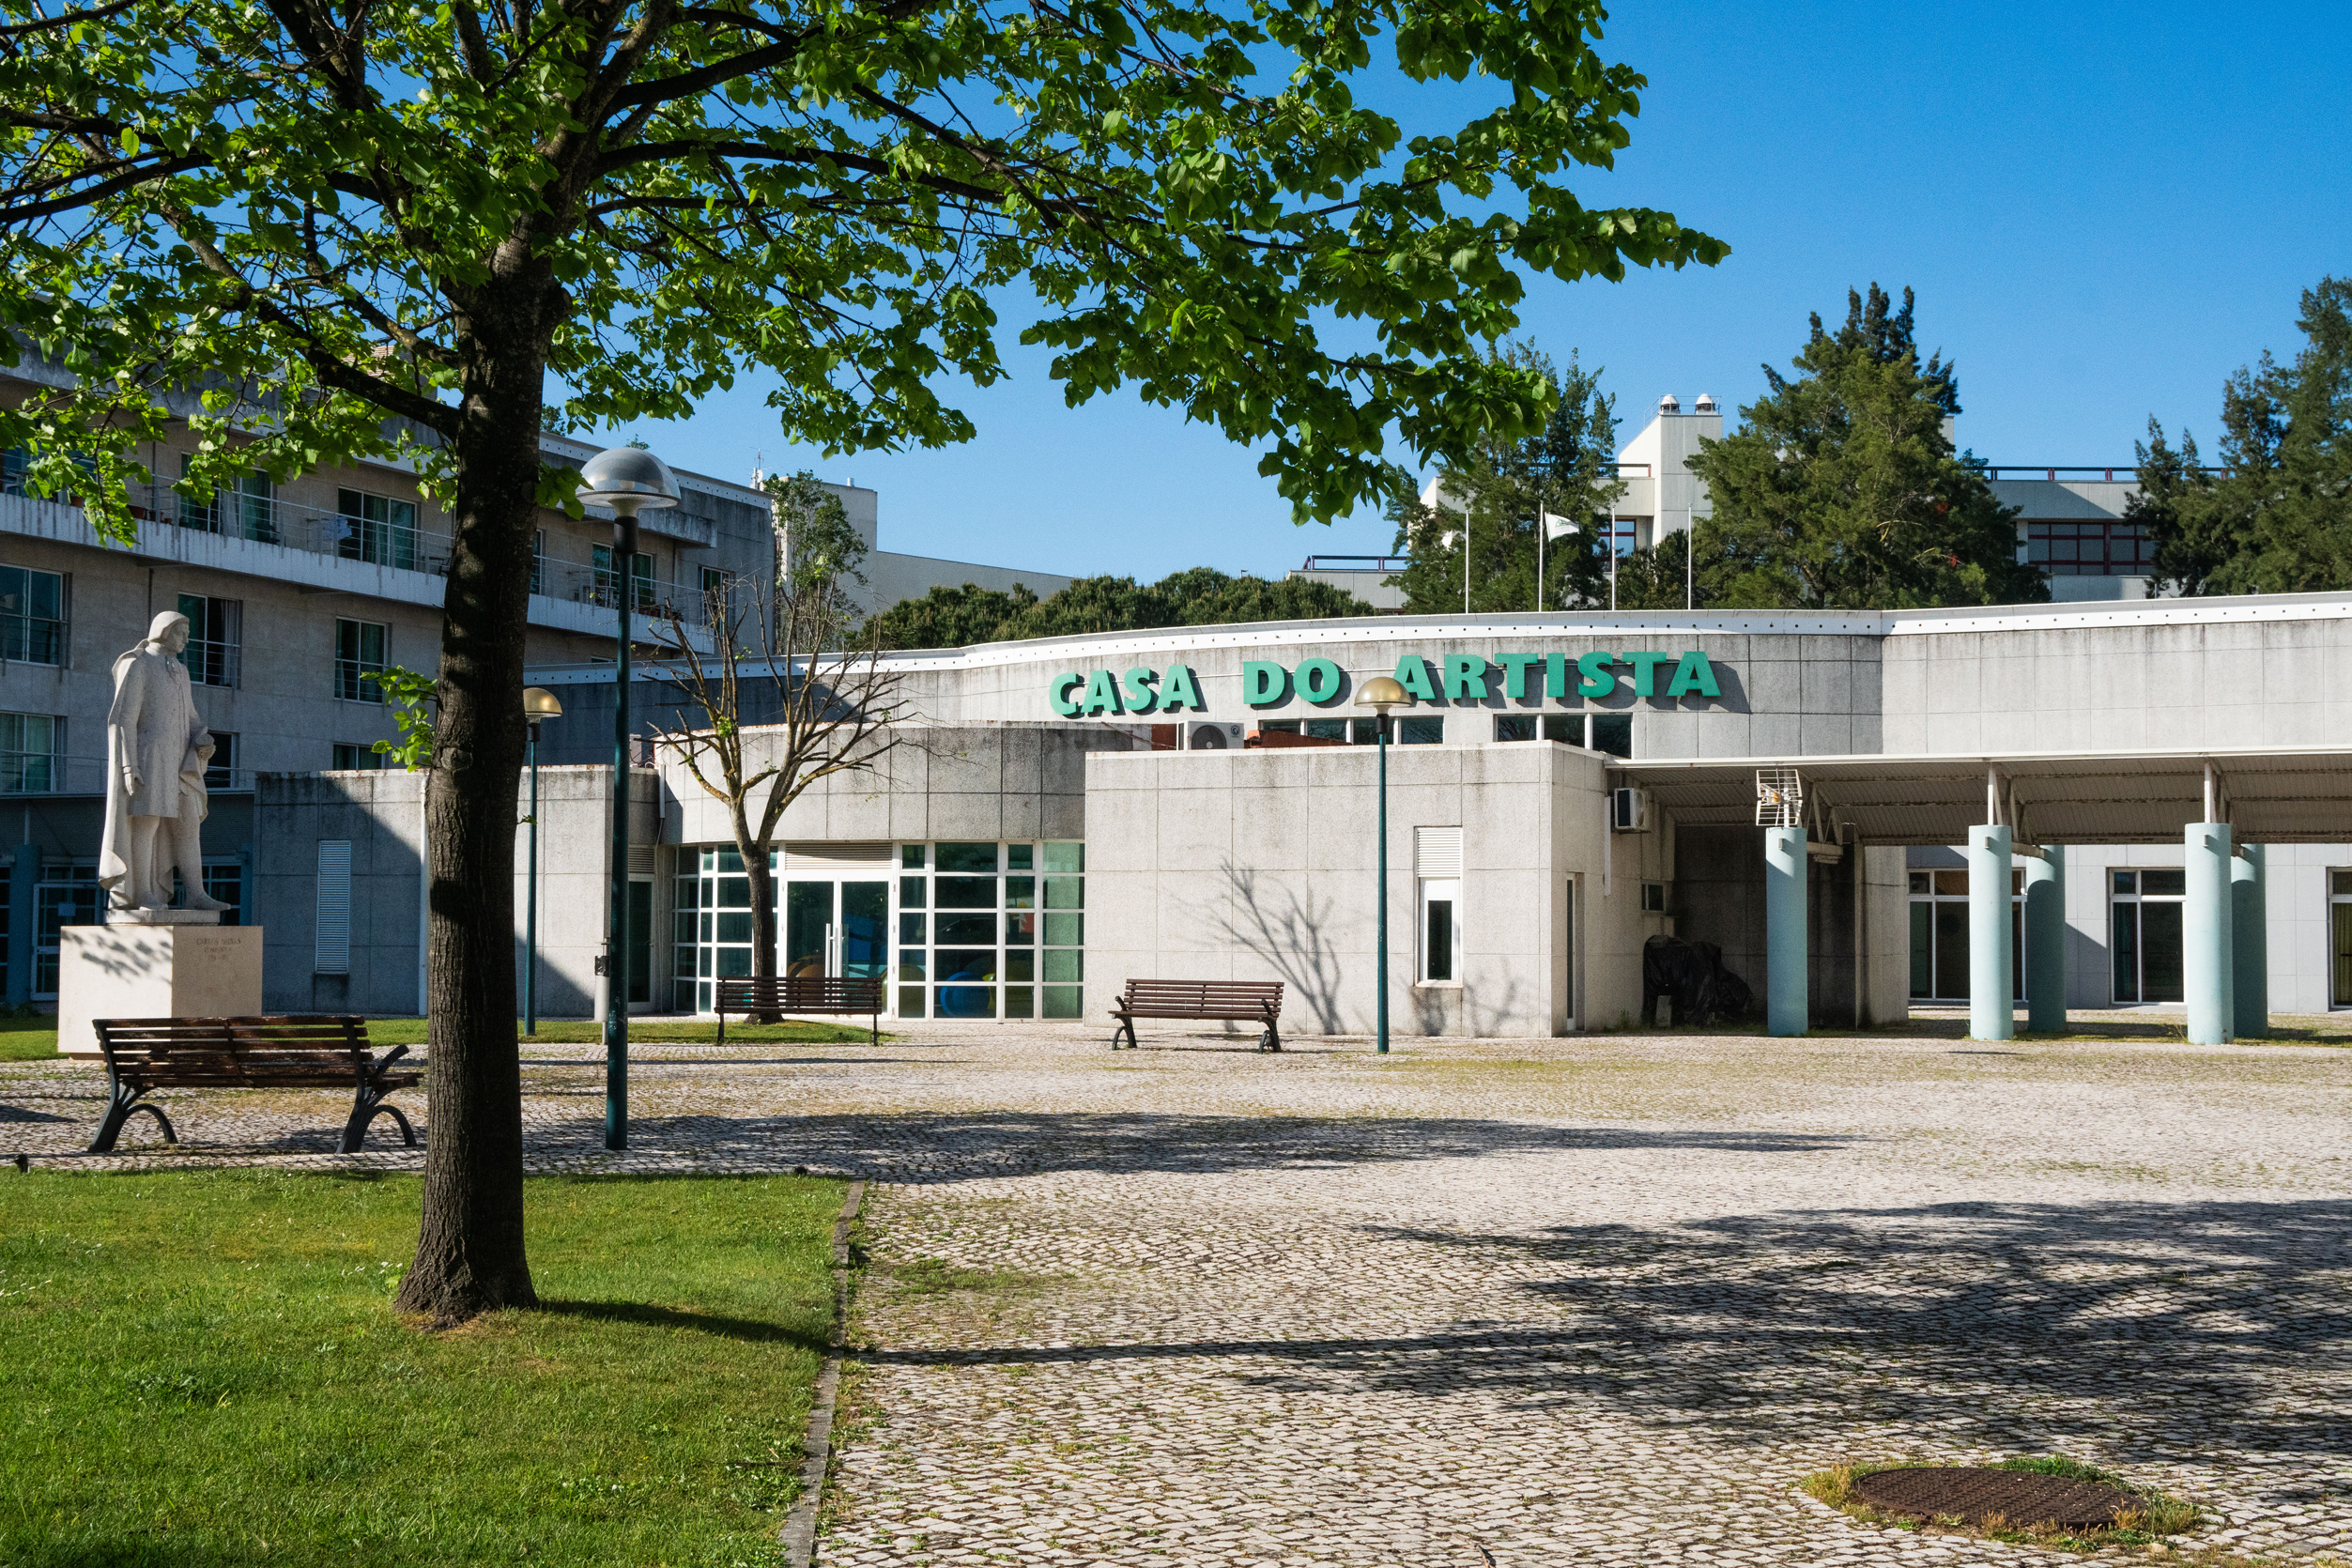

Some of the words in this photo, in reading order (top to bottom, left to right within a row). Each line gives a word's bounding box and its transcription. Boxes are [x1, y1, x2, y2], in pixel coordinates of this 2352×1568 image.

[1050, 665, 1199, 715] CASA
[1242, 658, 1341, 704] DO
[1393, 651, 1722, 699] ARTISTA
